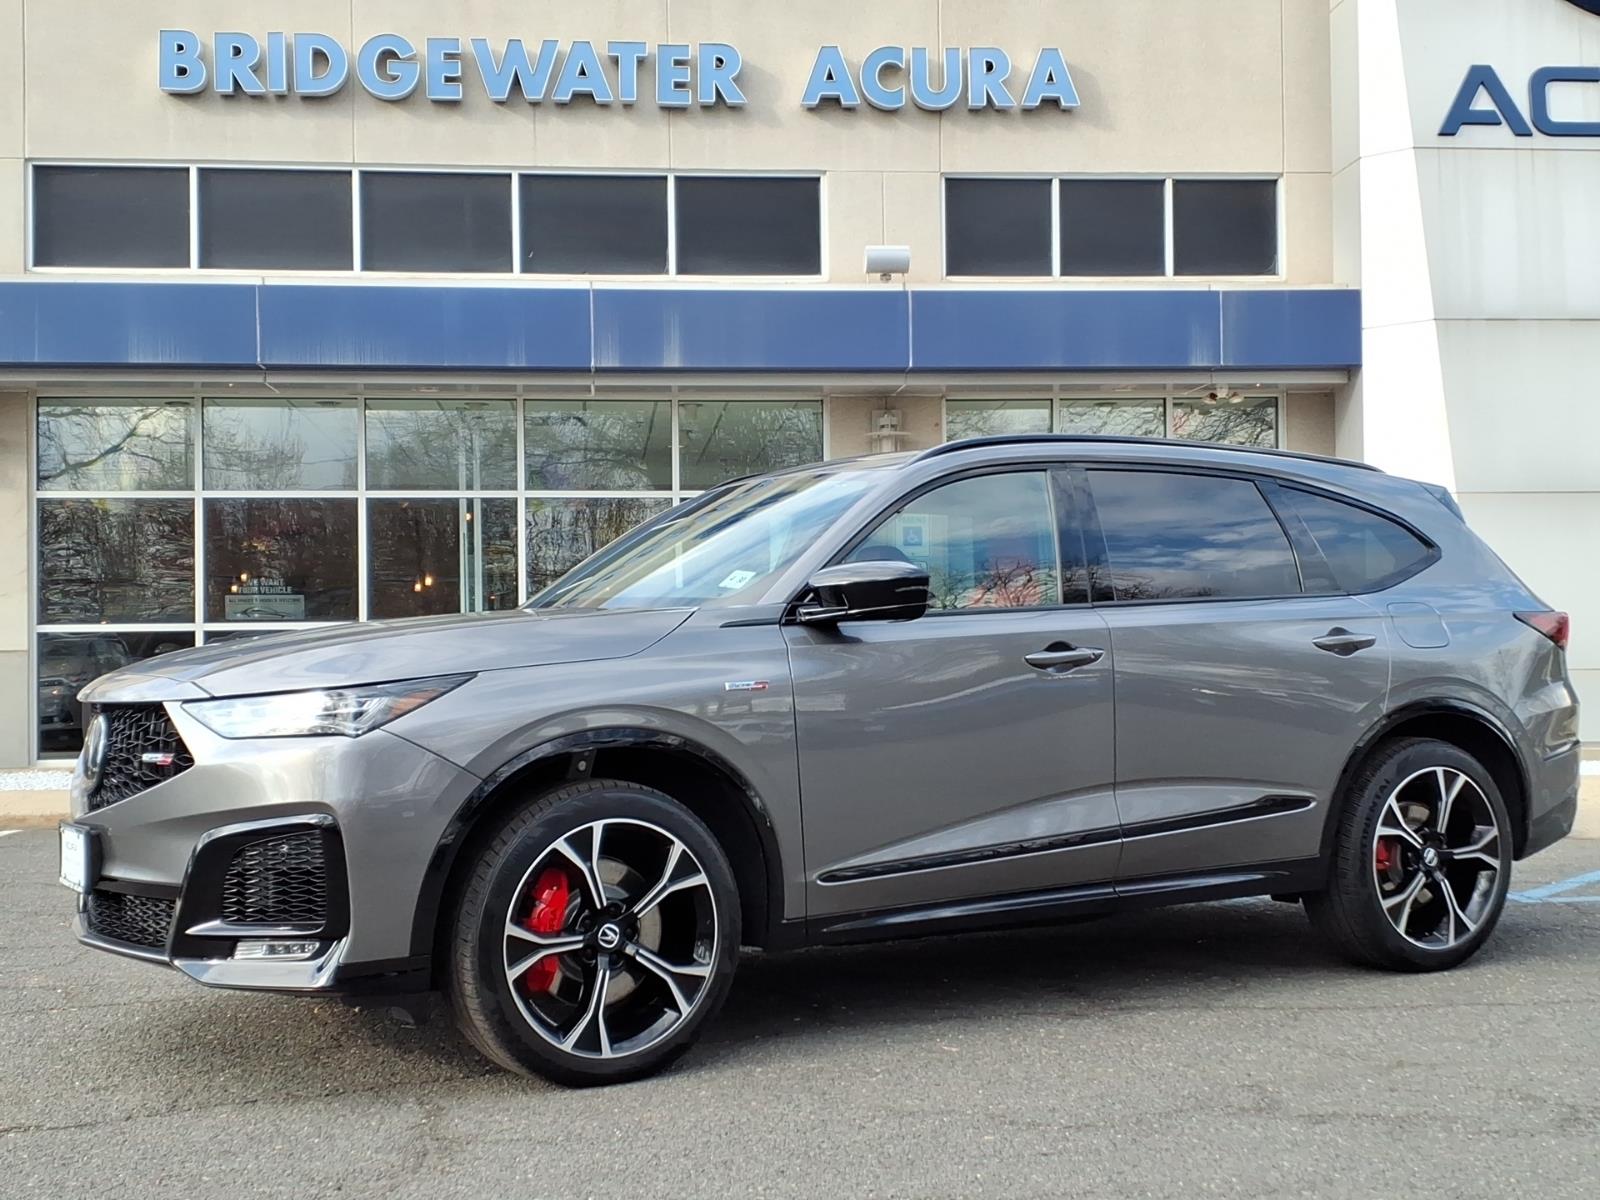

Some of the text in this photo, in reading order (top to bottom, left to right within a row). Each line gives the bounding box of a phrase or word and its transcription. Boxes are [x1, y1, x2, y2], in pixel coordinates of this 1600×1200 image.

[158, 28, 1081, 111] BRIDGEWATER ACURA
[1437, 64, 1600, 137] AC
[260, 586, 293, 594] VEHICLE
